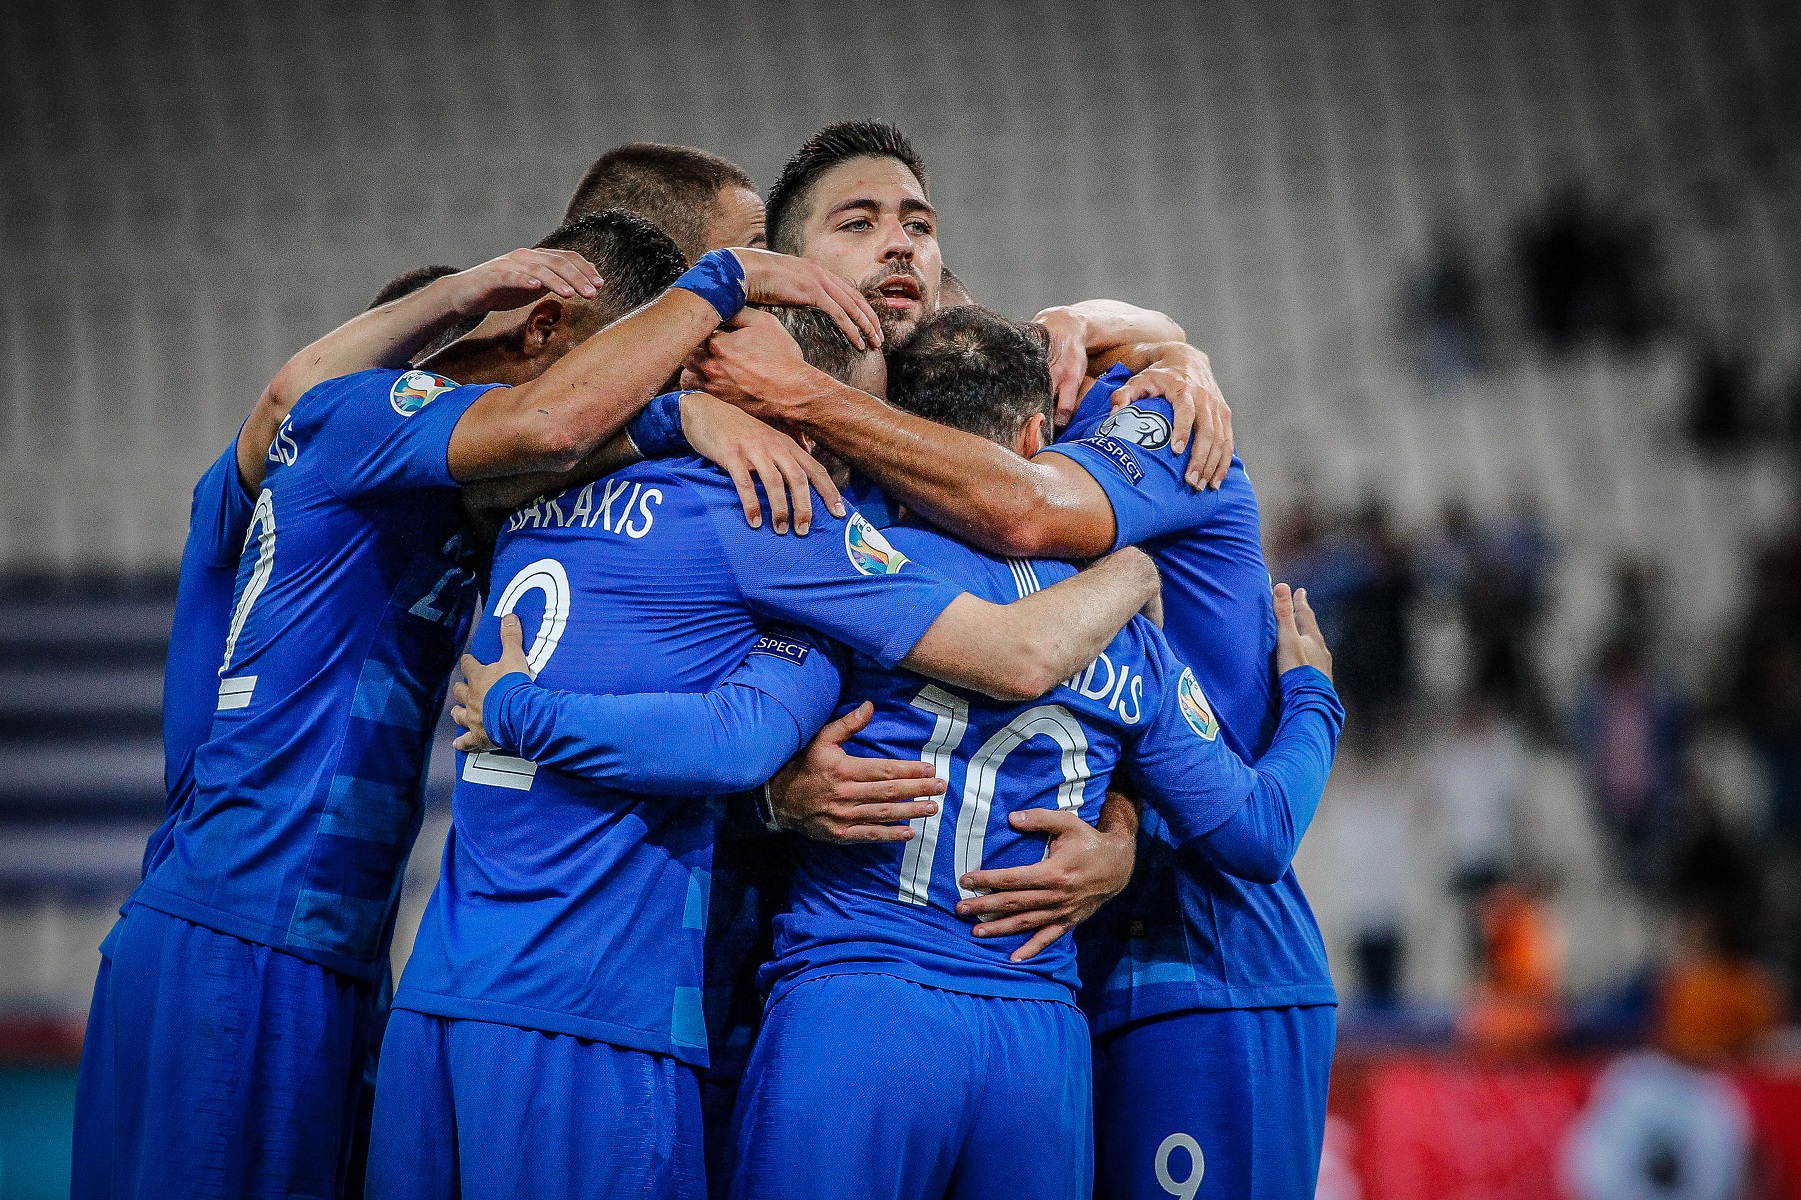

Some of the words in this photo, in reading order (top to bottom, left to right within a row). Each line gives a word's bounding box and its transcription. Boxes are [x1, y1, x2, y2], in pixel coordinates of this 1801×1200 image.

[754, 637, 808, 658] SPECT
[1062, 652, 1143, 725] DIS
[898, 683, 1091, 923] 10
[1155, 1132, 1205, 1200] 9
